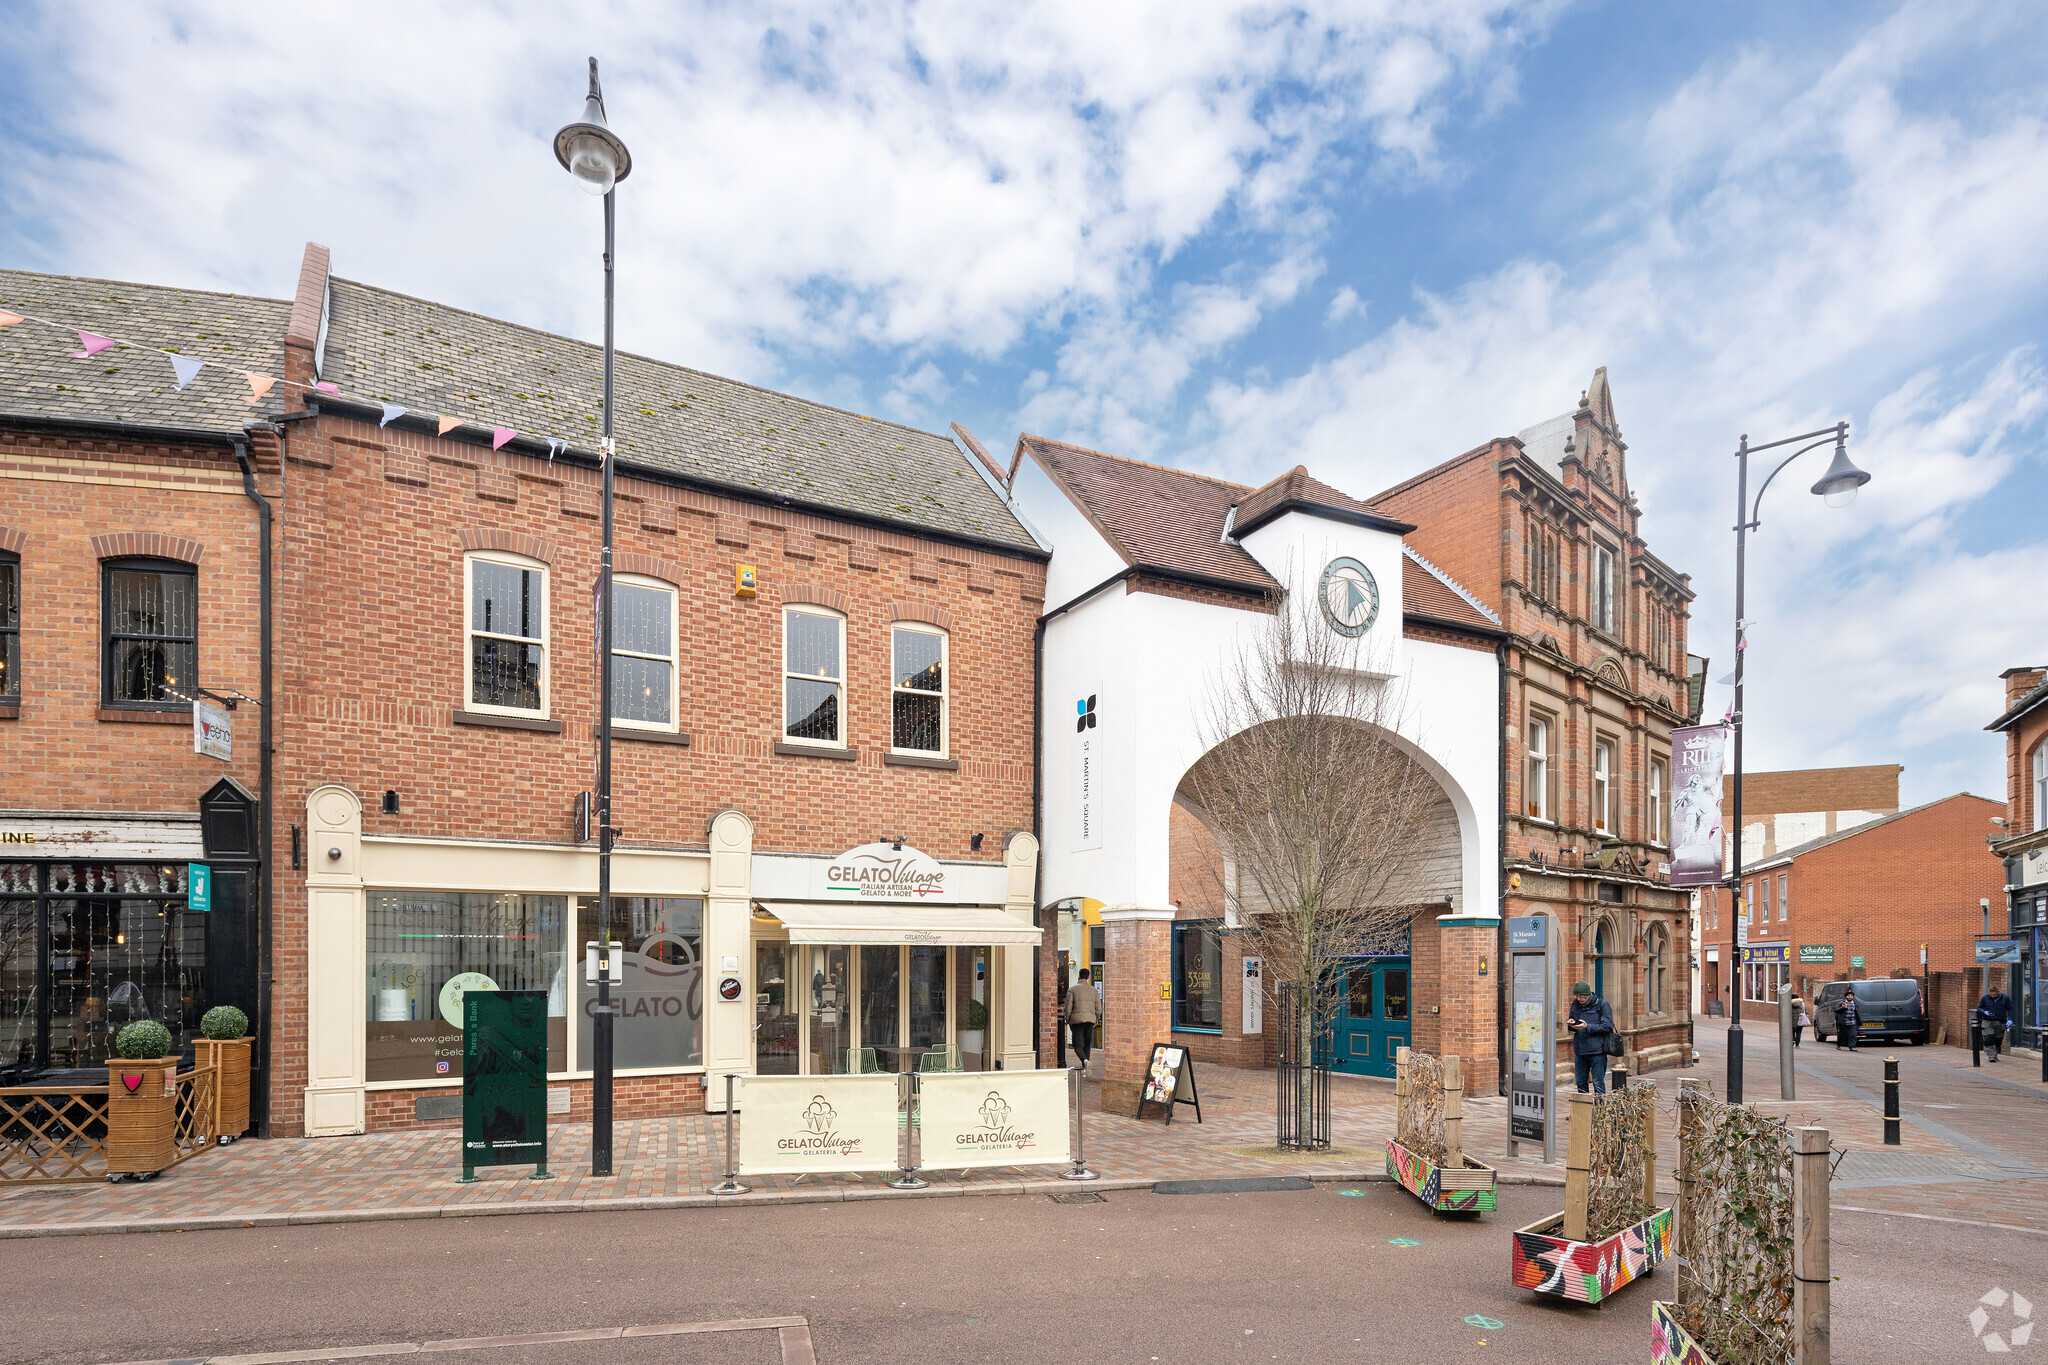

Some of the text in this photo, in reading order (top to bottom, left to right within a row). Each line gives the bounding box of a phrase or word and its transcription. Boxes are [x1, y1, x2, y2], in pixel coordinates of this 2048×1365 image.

[827, 866, 891, 883] GELATO
[601, 961, 606, 969] 1
[1187, 972, 1199, 988] 33
[1162, 984, 1171, 997] H
[777, 1138, 823, 1149] GELATO
[954, 1133, 999, 1144] GELATO
